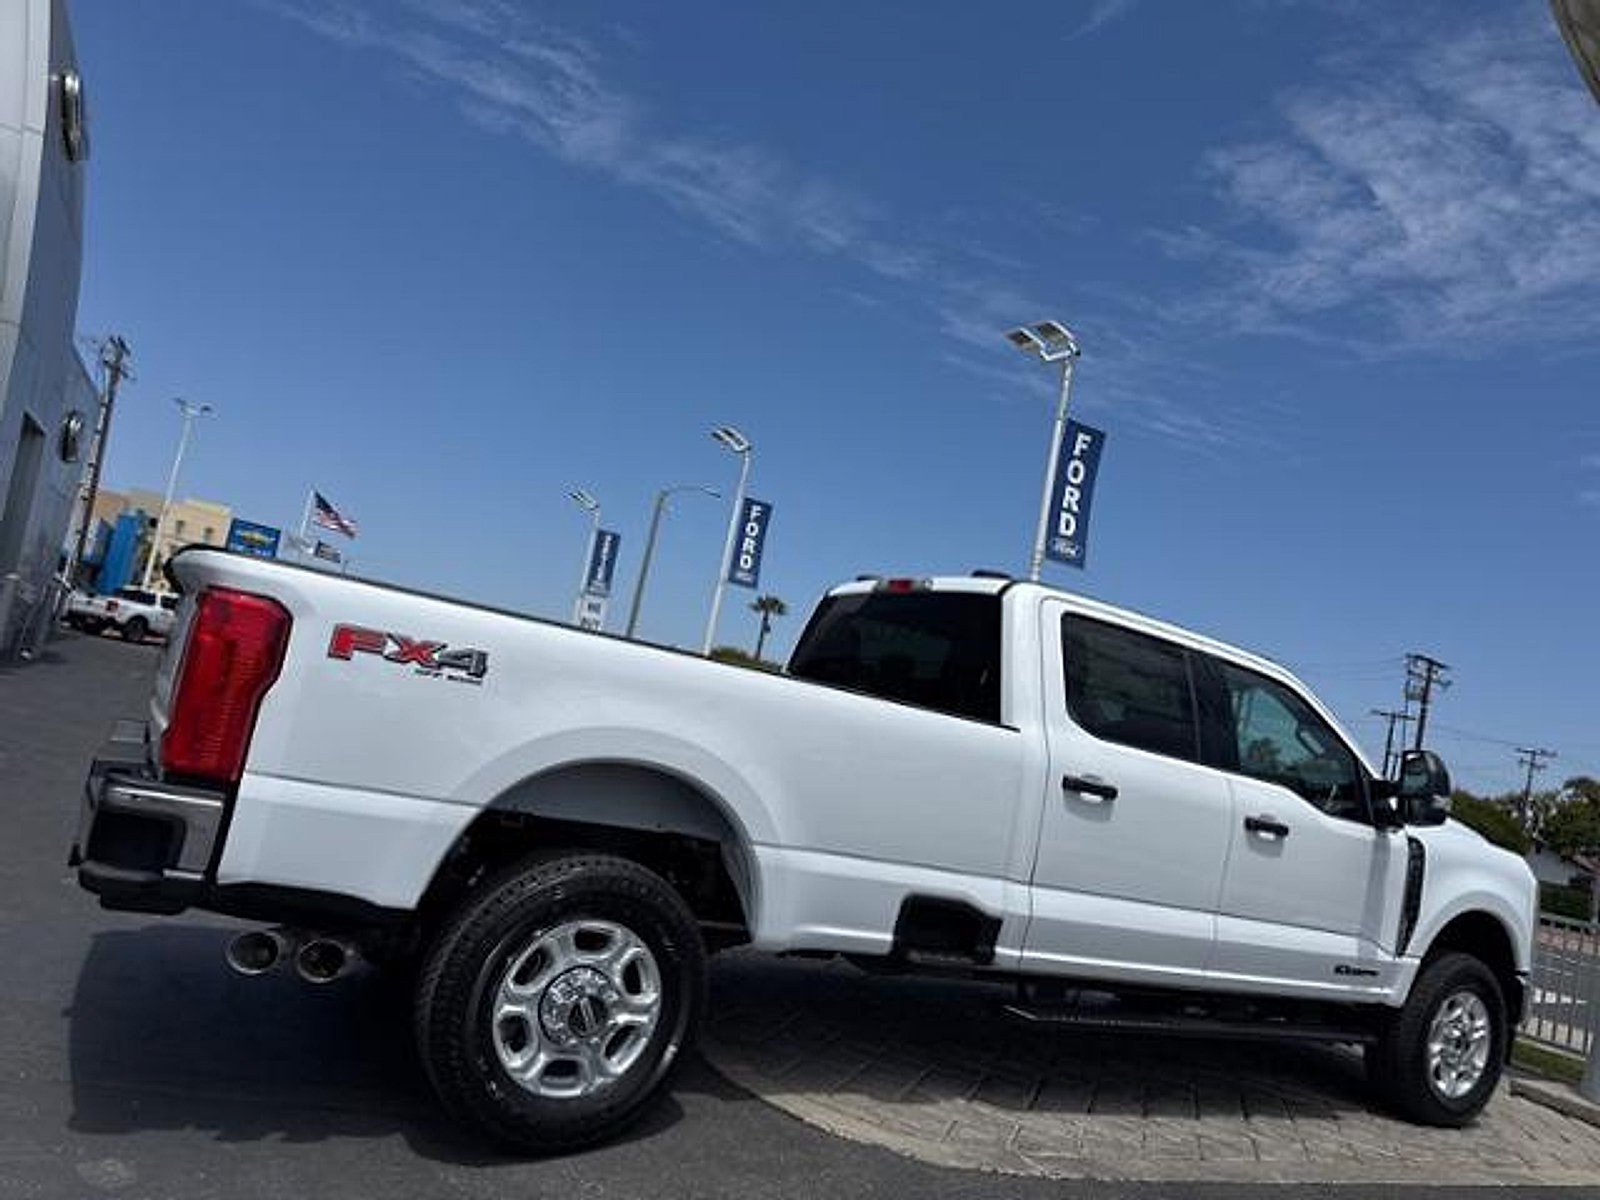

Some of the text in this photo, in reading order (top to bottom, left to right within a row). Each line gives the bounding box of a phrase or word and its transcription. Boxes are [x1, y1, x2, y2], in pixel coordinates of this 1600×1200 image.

[1058, 432, 1092, 537] FORD
[740, 505, 761, 569] FORD
[328, 623, 488, 678] FX4
